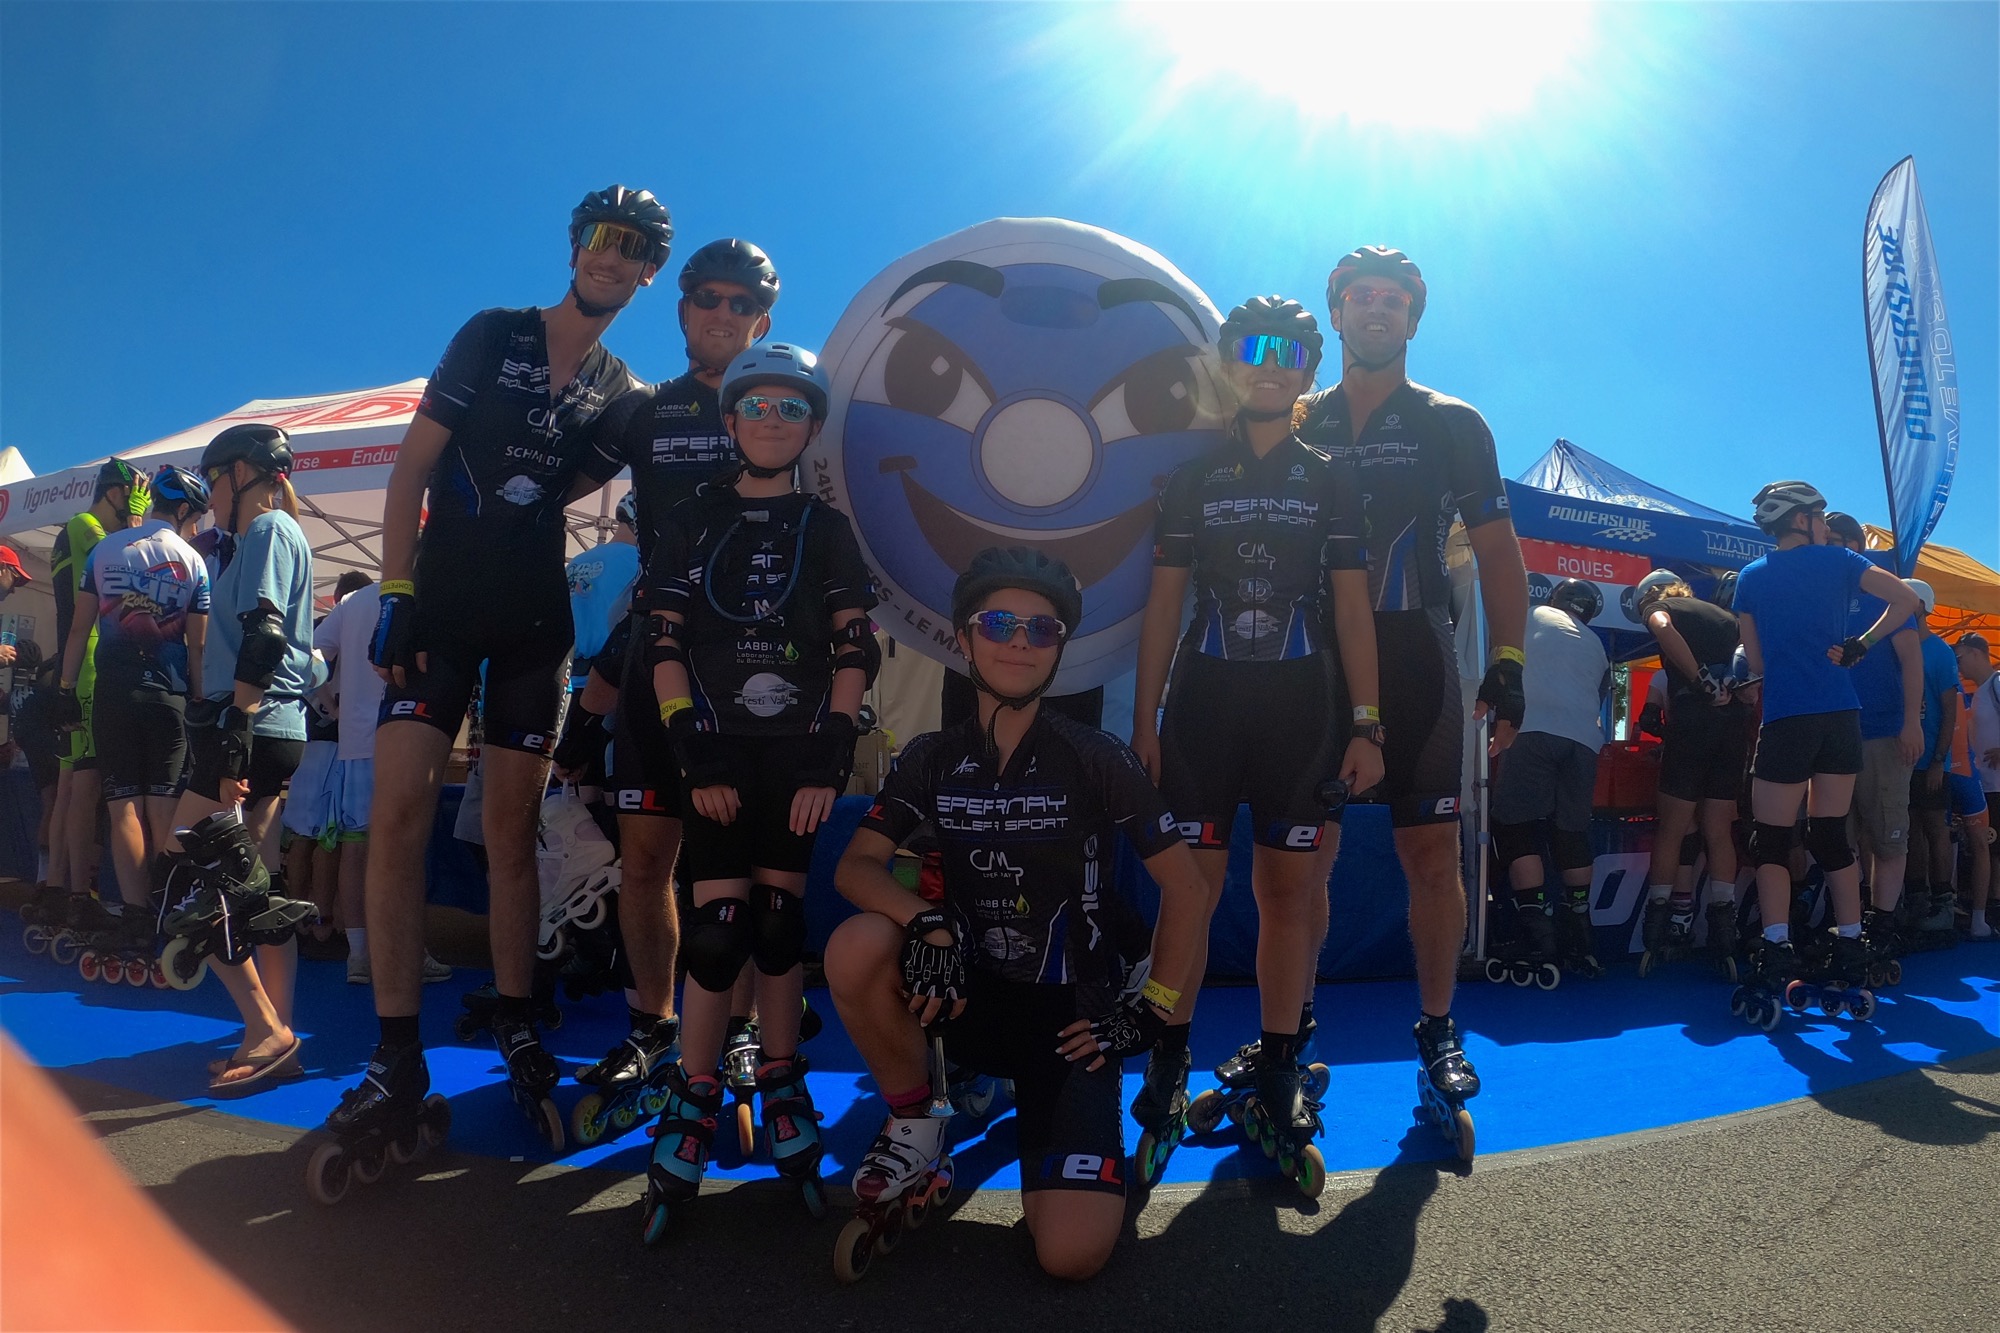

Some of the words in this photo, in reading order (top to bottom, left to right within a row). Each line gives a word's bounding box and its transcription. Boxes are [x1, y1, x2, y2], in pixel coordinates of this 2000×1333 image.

[1878, 223, 1937, 444] POWERSLIDE
[1929, 327, 1956, 376] TO
[504, 445, 564, 468] SCHMIDT
[1313, 442, 1419, 459] PERNAY
[1360, 456, 1419, 468] SPORT
[813, 457, 837, 504] 24H
[23, 474, 97, 513] ligne-droi
[1203, 498, 1319, 518] EPERNAY
[1548, 505, 1651, 531] POWERSLIDE
[1267, 513, 1317, 528] SPORT
[102, 565, 140, 576] CIRCUIT
[1557, 555, 1614, 579] ROUES
[102, 572, 187, 608] 24H
[903, 610, 932, 635] LE
[933, 628, 968, 660] MA
[936, 794, 1067, 817] EPERNAY
[1004, 816, 1069, 833] SPORT
